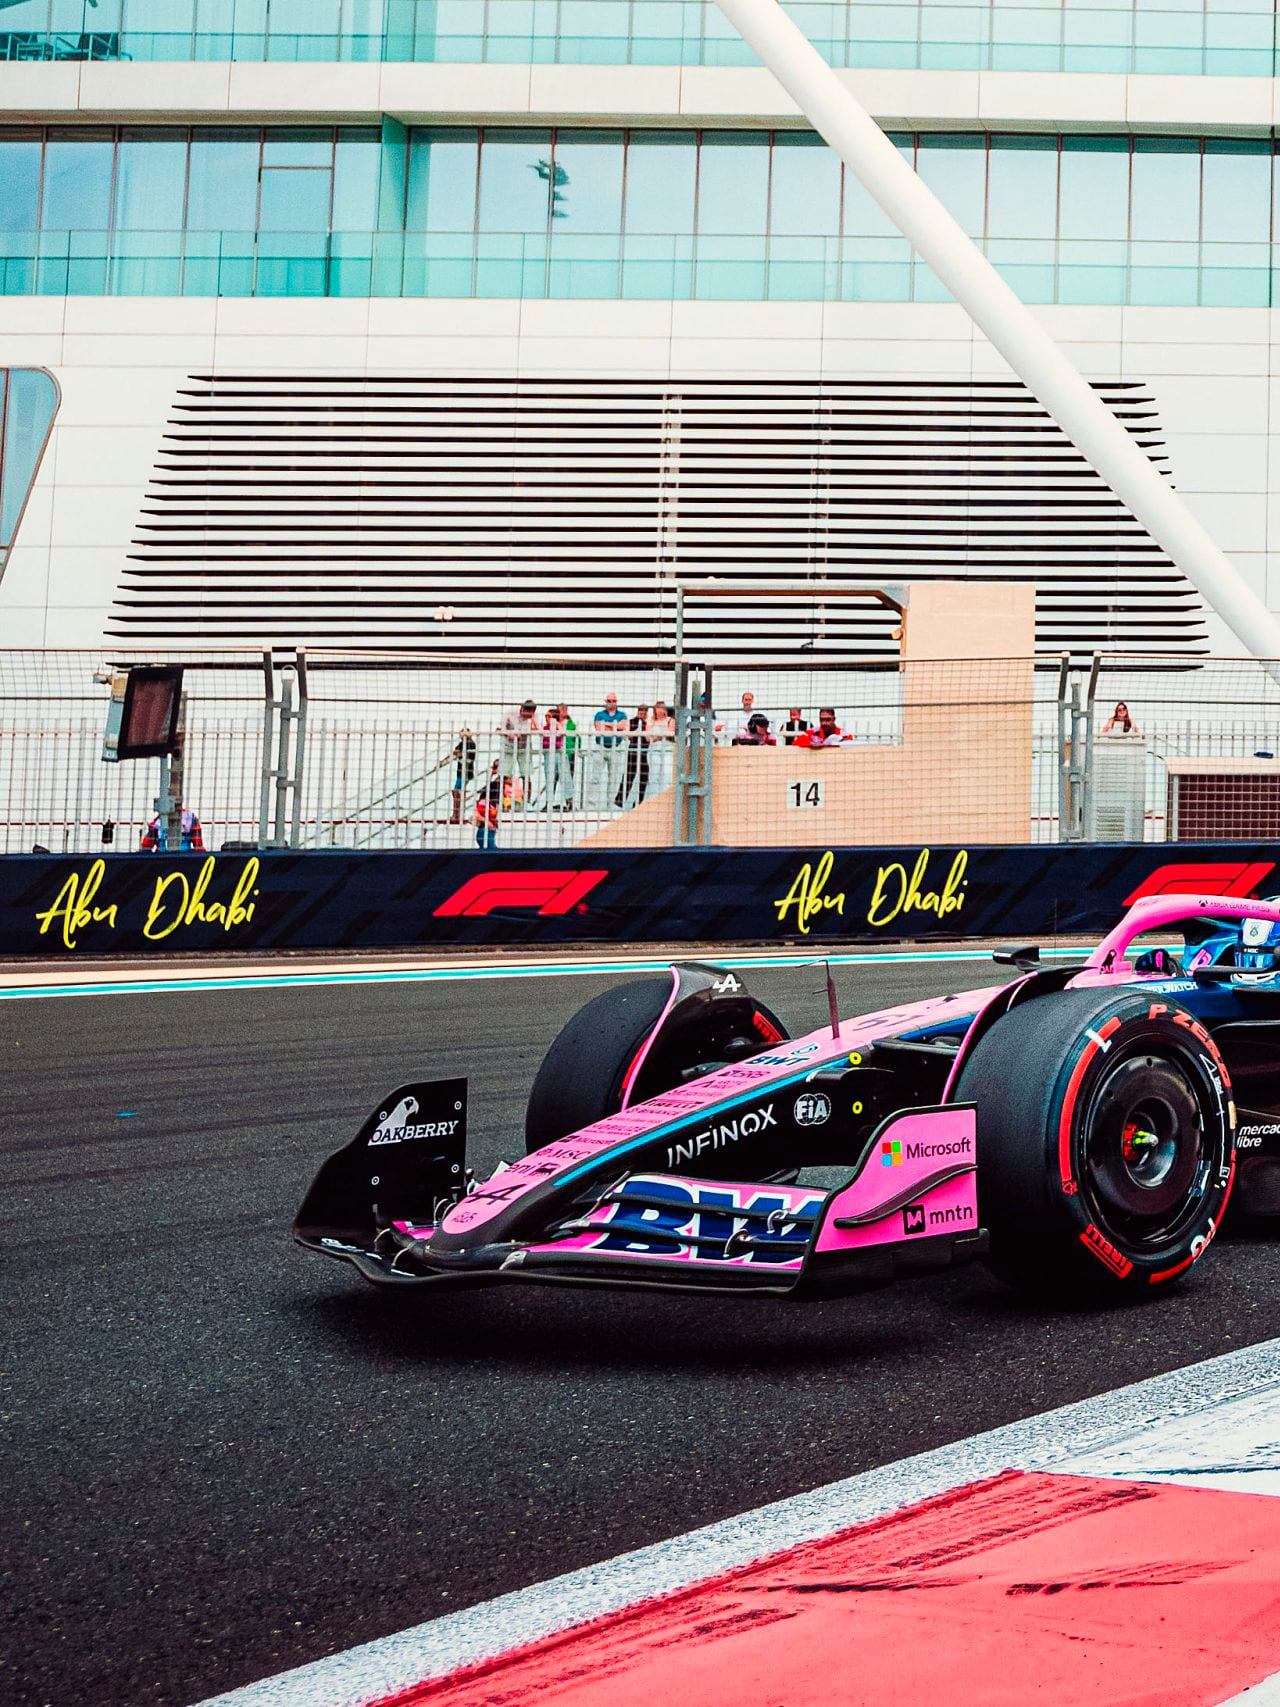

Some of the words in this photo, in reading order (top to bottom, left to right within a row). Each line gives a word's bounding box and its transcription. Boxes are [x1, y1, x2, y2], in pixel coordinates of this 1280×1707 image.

[791, 782, 821, 807] 14
[35, 859, 118, 949] Abu
[143, 856, 260, 940] Dhabi
[432, 870, 609, 917] F1
[774, 851, 846, 934] Abu
[867, 848, 968, 927] Dhabi
[745, 1055, 811, 1067] BWT
[371, 1119, 459, 1144] OAKBERRY
[667, 1103, 778, 1168] INFINOX
[1236, 1135, 1263, 1149] libre
[906, 1137, 972, 1160] Microsoft
[929, 1205, 974, 1225] mntn
